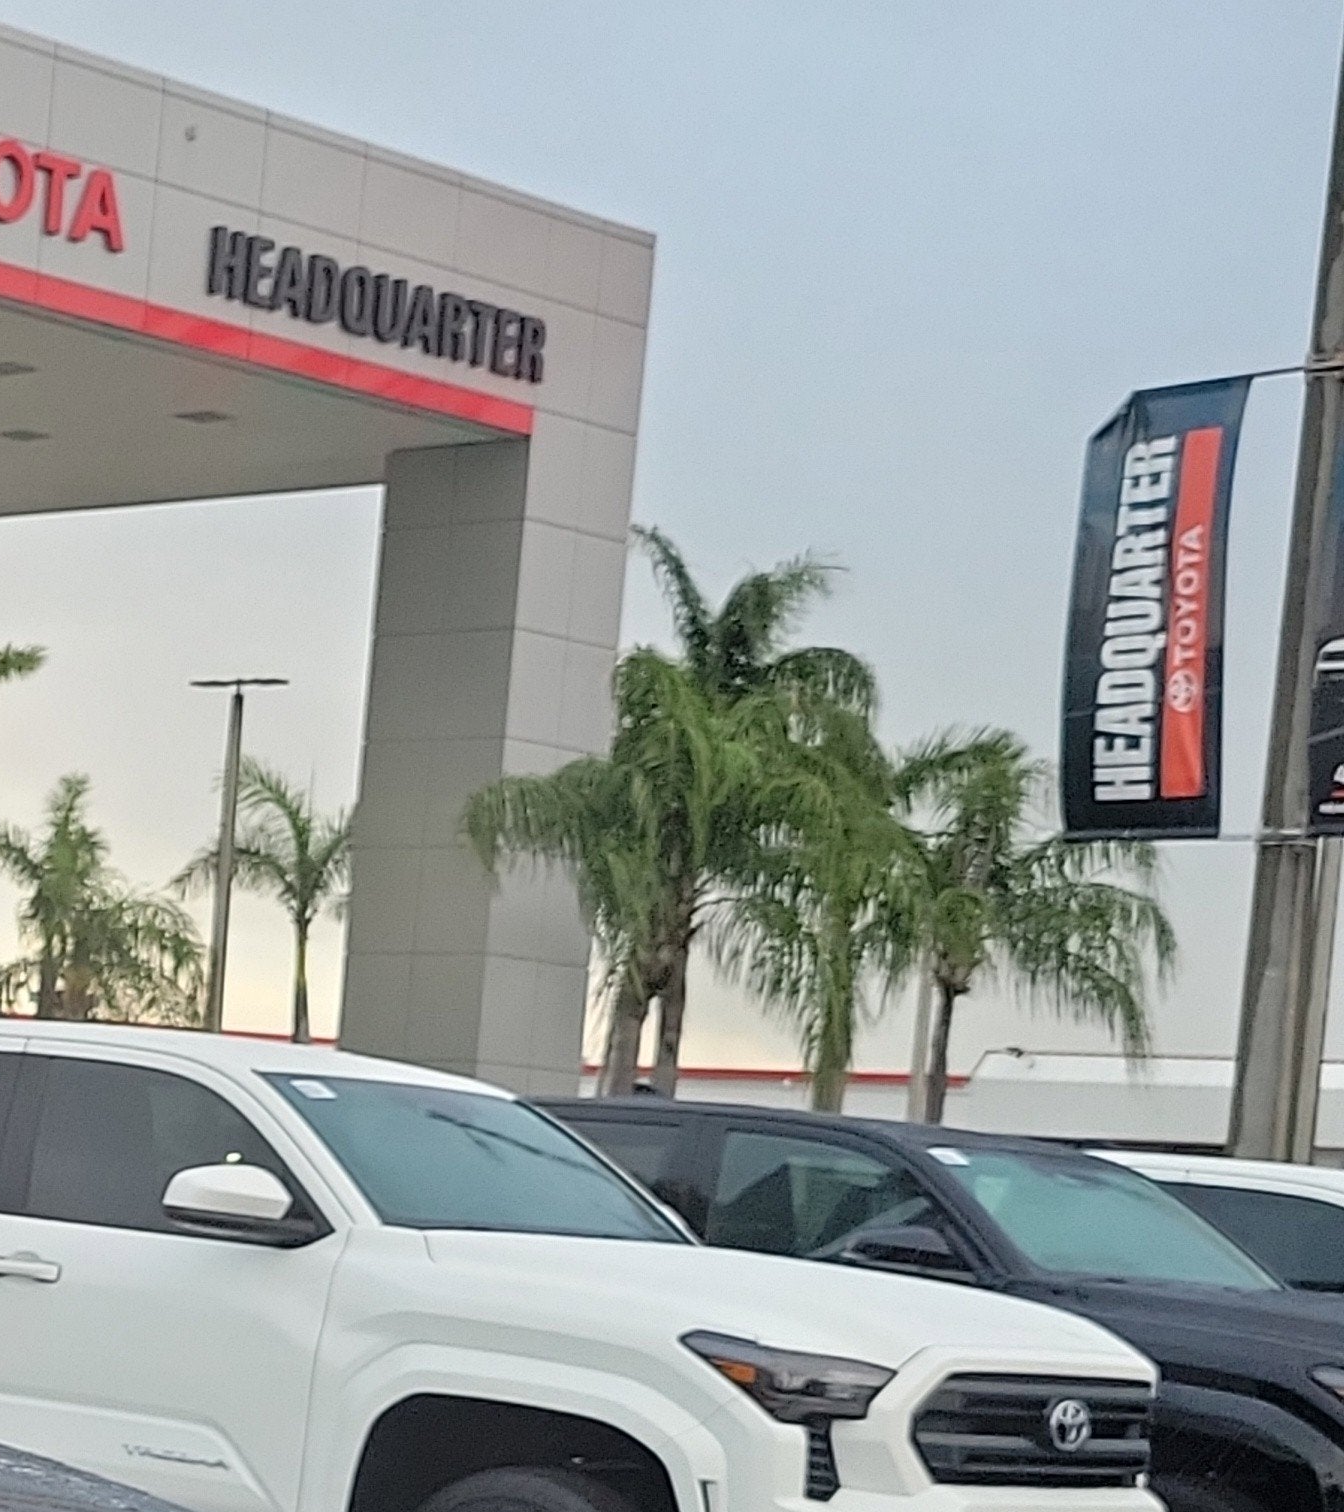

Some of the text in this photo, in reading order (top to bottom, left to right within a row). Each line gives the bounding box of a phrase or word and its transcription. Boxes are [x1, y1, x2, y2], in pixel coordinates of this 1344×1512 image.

[207, 226, 546, 384] HEADQUARTER
[1093, 435, 1177, 800] HEADQUARTER
[1173, 524, 1204, 666] TOYOTA
